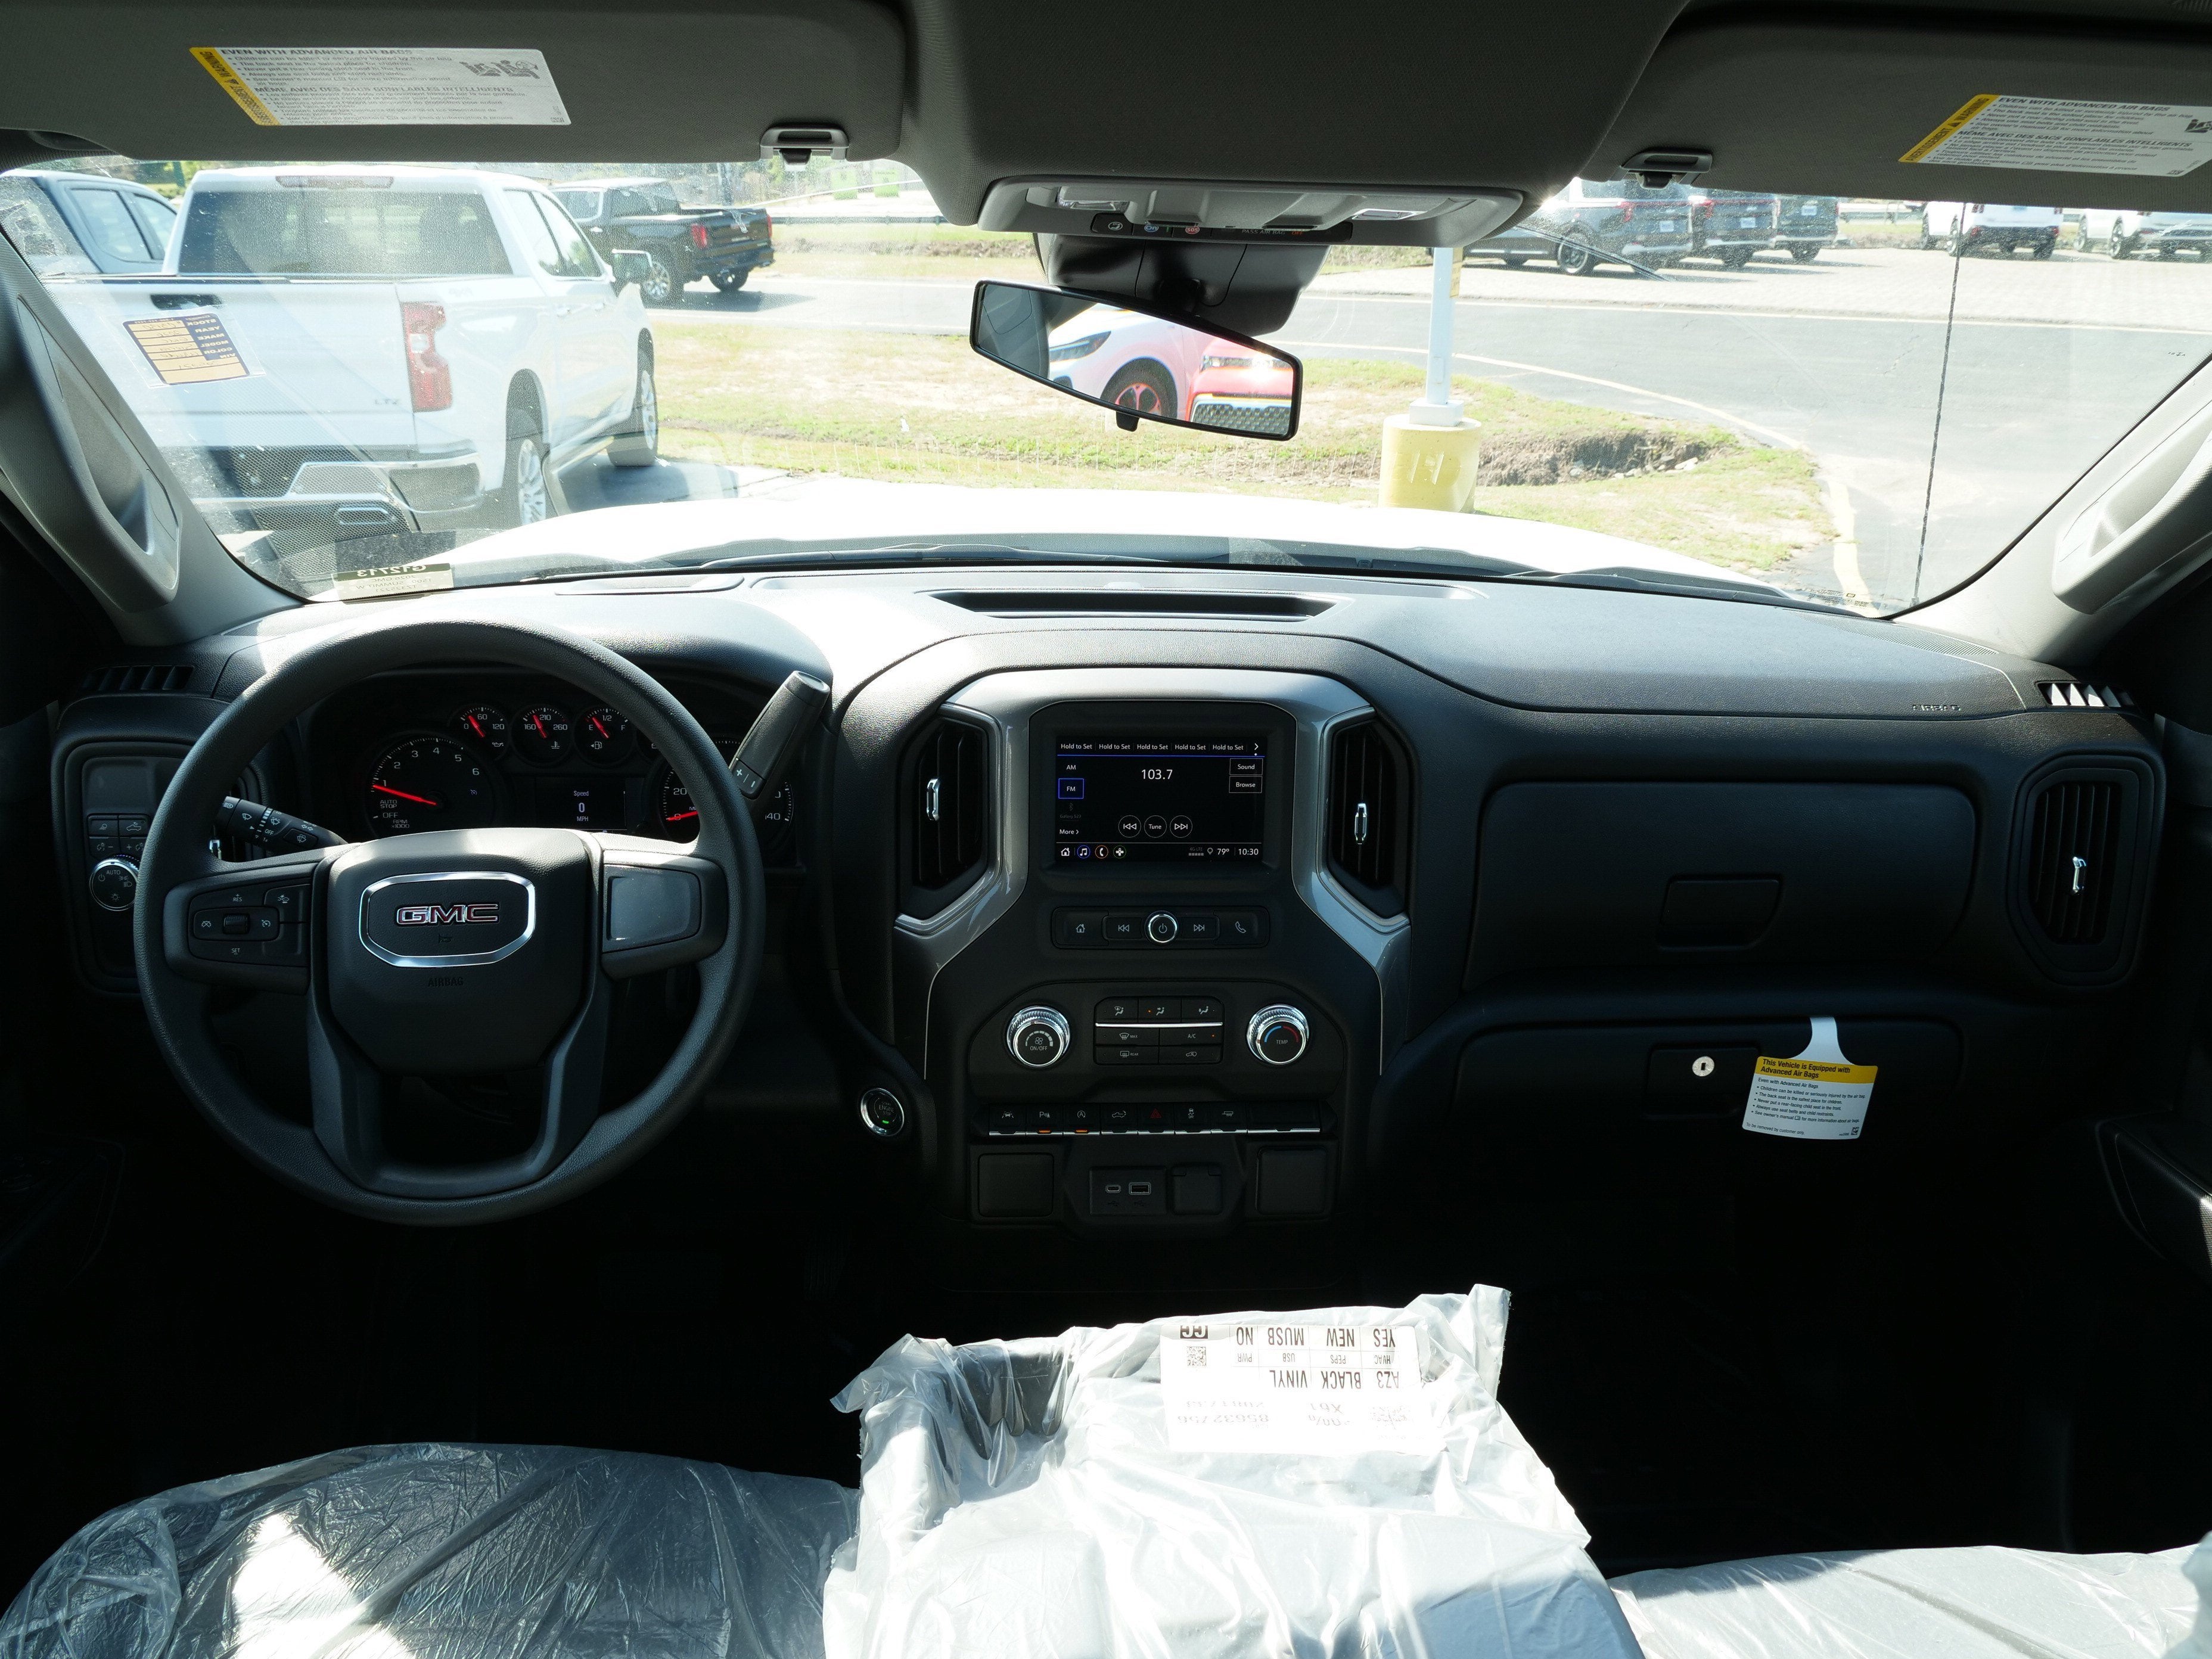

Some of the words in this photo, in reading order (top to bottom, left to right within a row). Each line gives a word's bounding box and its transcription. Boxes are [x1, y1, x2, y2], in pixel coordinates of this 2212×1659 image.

[199, 51, 232, 77] WARNING
[1953, 98, 1990, 122] WARNING
[1958, 129, 1991, 138] MÊME
[2064, 136, 2124, 144] GONFLABLES
[1912, 703, 1961, 712] AIRBAG
[1141, 769, 1173, 779] 103.7
[579, 803, 585, 812] 0
[396, 903, 499, 925] GMC
[427, 976, 465, 988] AIRBAG
[1761, 1067, 1791, 1075] Advanced
[1237, 1326, 1253, 1346] NO
[1267, 1327, 1304, 1346] MUSB
[1326, 1328, 1354, 1347] NEW
[1374, 1328, 1396, 1348] YES
[1237, 1352, 1253, 1363] PWR
[1282, 1353, 1295, 1362] USB
[1330, 1354, 1346, 1364] PEPS
[1374, 1354, 1391, 1365] HVAC
[1270, 1370, 1308, 1388] VINYL
[1322, 1371, 1361, 1389] BLACK
[1377, 1371, 1399, 1389] AZ3
